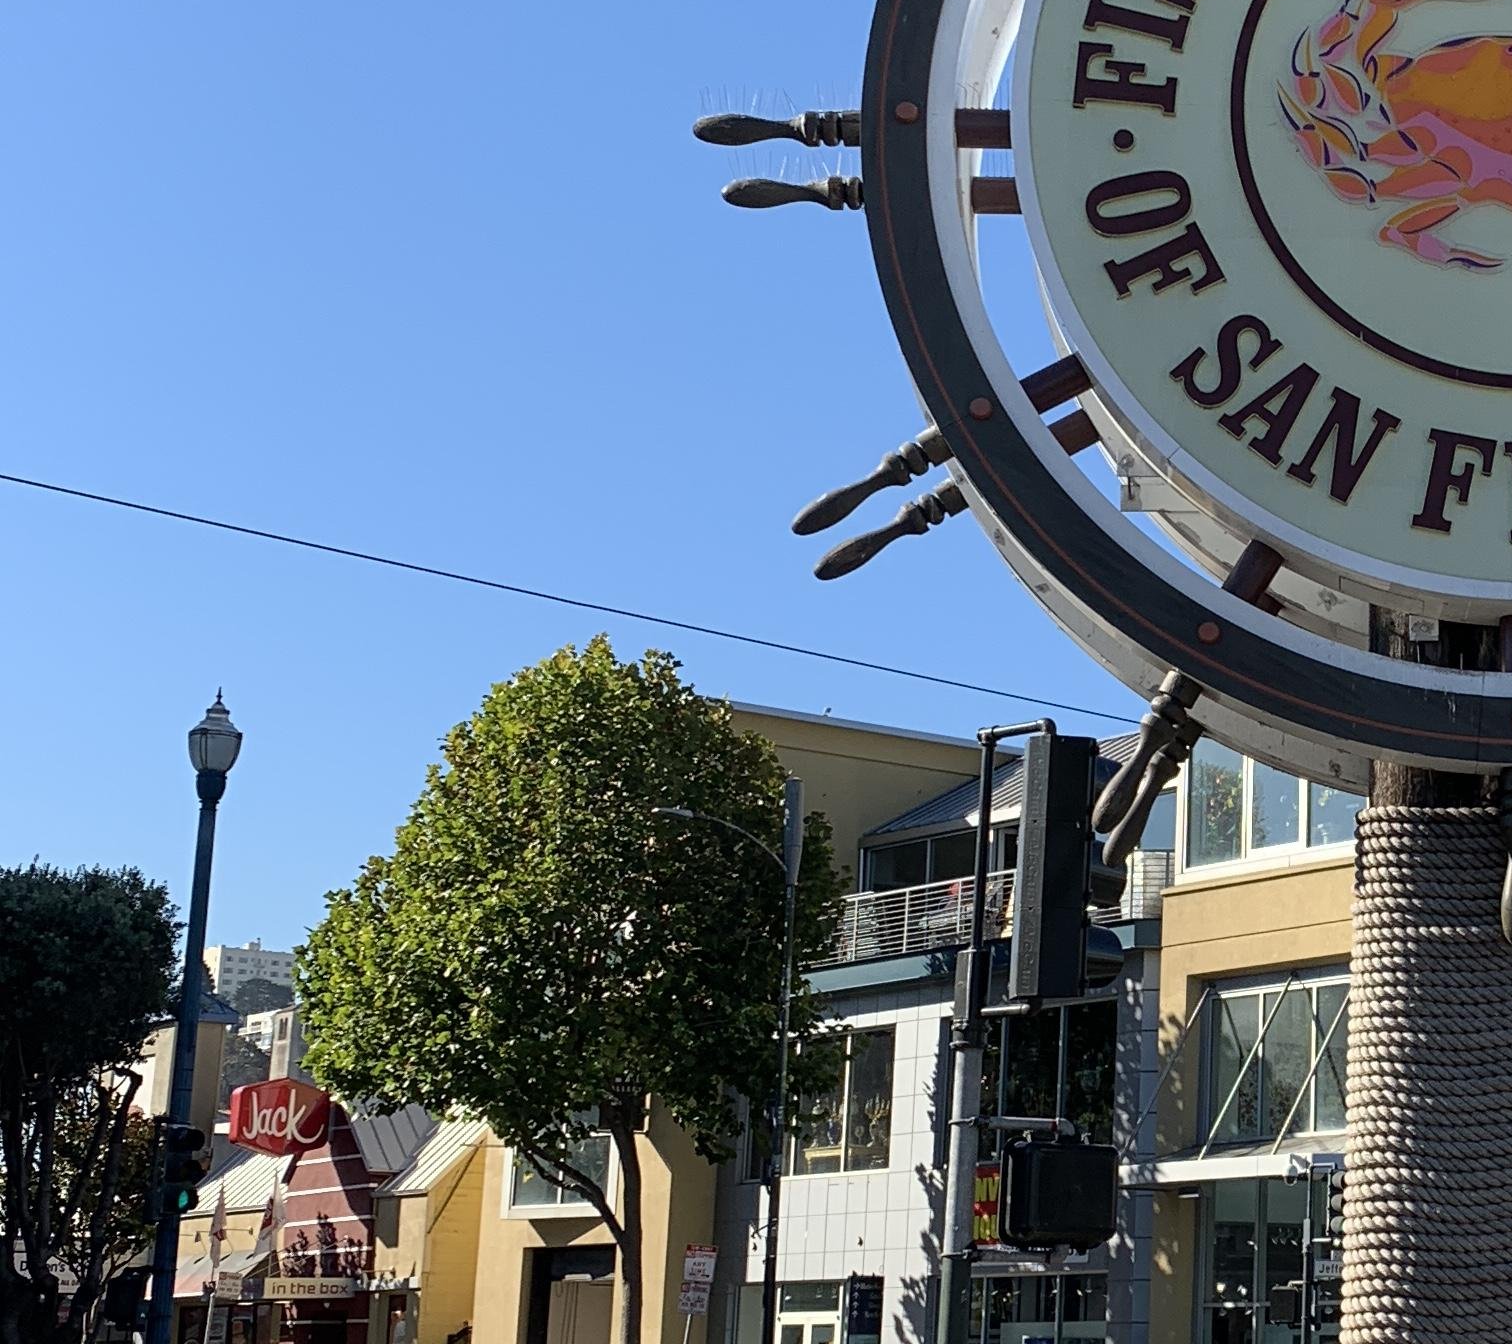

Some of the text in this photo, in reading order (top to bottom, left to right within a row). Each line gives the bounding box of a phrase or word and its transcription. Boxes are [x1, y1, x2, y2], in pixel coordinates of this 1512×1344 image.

[1084, 169, 1226, 300] OF
[1170, 312, 1401, 507] SAN
[243, 1089, 324, 1144] Jack
[271, 1282, 349, 1295] in the box
